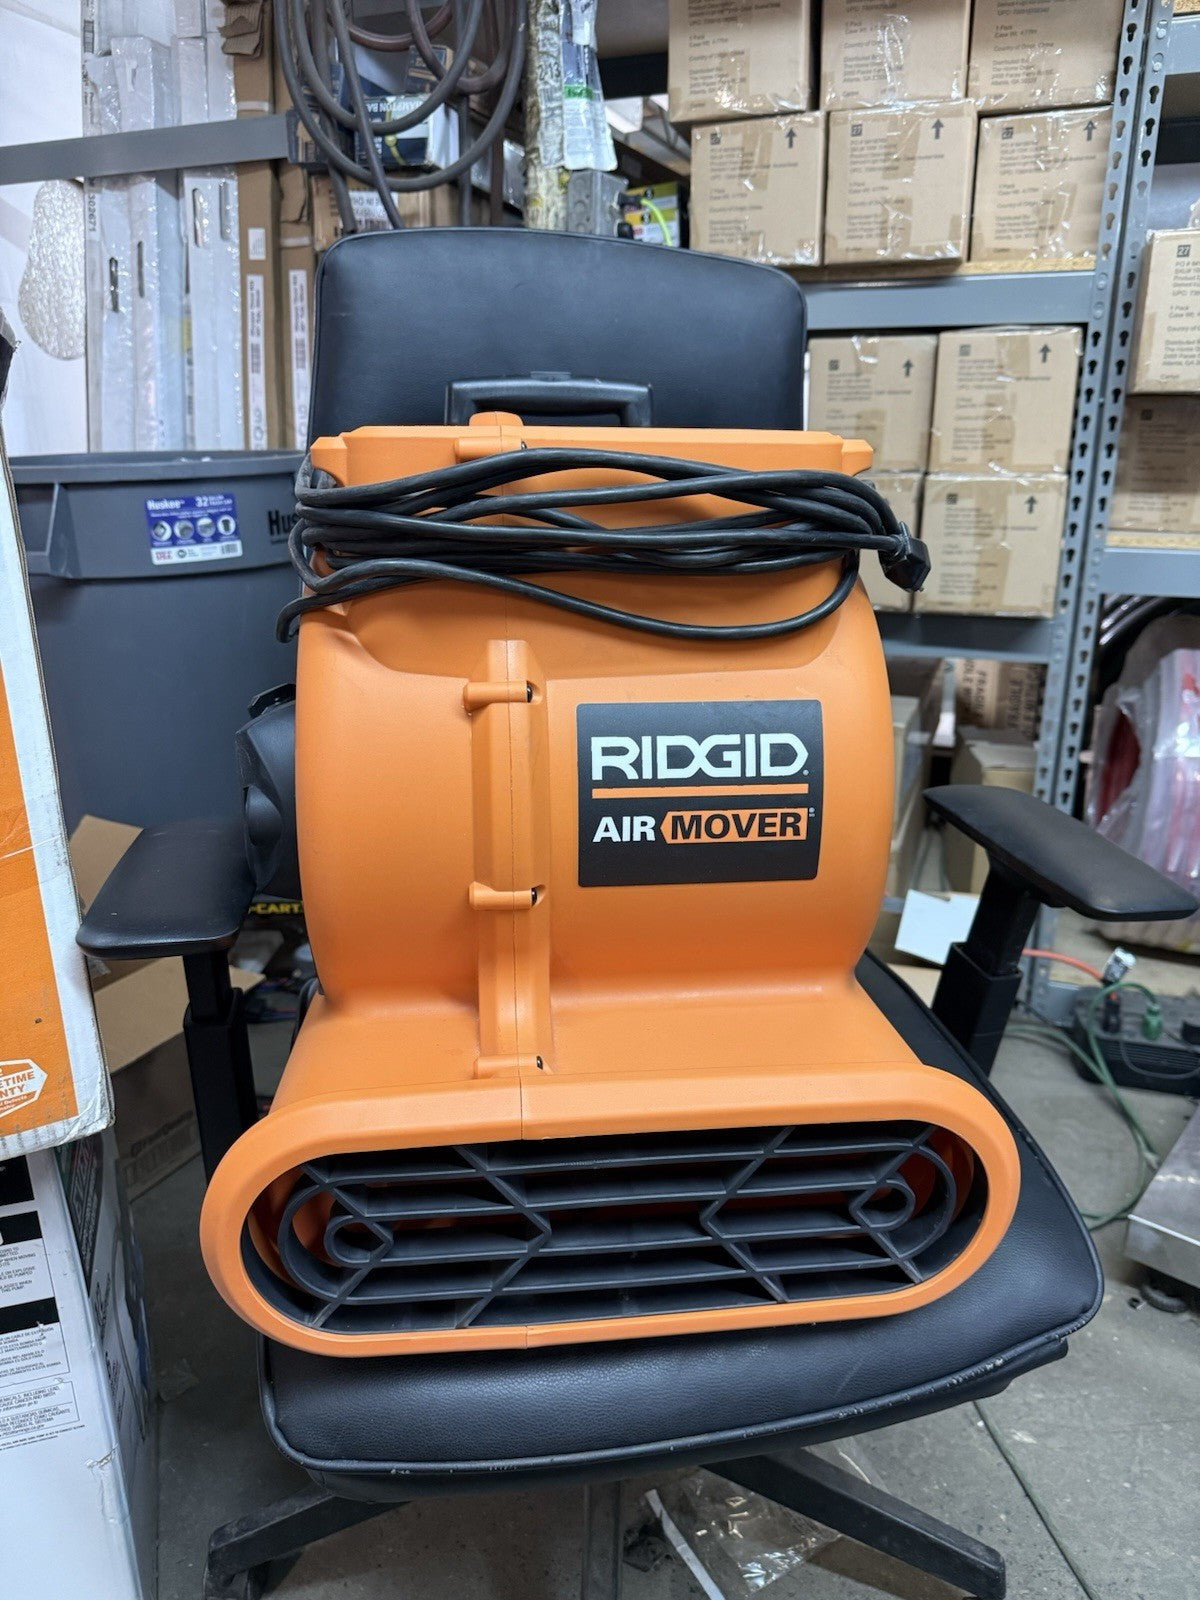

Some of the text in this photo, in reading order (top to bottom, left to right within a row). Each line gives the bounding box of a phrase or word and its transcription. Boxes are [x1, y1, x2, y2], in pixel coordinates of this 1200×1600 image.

[1177, 245, 1190, 257] 27
[591, 733, 809, 780] RIDGID
[592, 812, 803, 843] AIR MOVER
[0, 1071, 35, 1089] TIME
